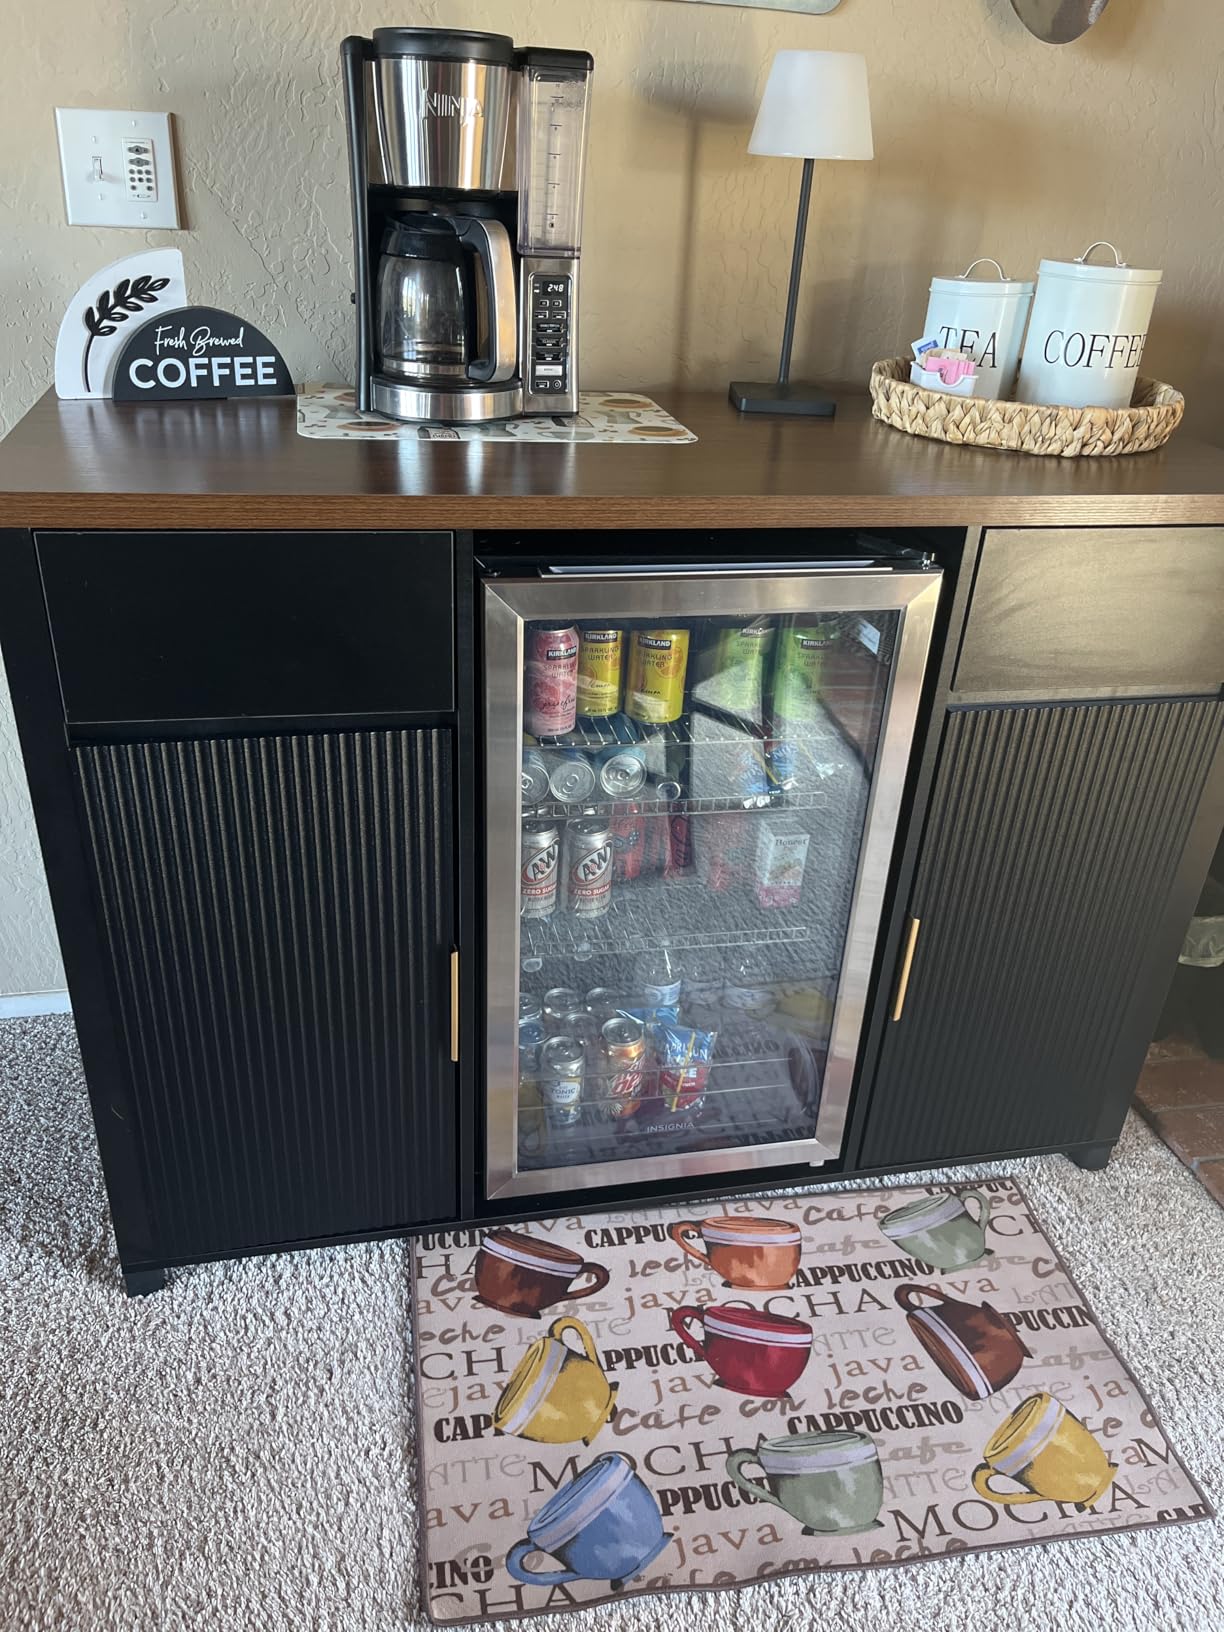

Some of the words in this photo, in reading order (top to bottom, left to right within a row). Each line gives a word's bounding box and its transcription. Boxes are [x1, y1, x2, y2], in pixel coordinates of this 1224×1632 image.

[154, 325, 187, 355] Fresh
[190, 327, 244, 356] Brewed
[939, 326, 998, 369] TEA
[129, 356, 277, 389] COFFEE
[585, 633, 618, 641] KIRKLAND
[639, 637, 672, 647] KIRKLAND
[647, 1121, 695, 1133] INSIGNIA
[624, 1287, 718, 1321] java
[827, 1353, 925, 1389] java
[824, 1379, 928, 1410] leche
[787, 1400, 964, 1436] CAPPUCCINO
[671, 1521, 784, 1570] java
